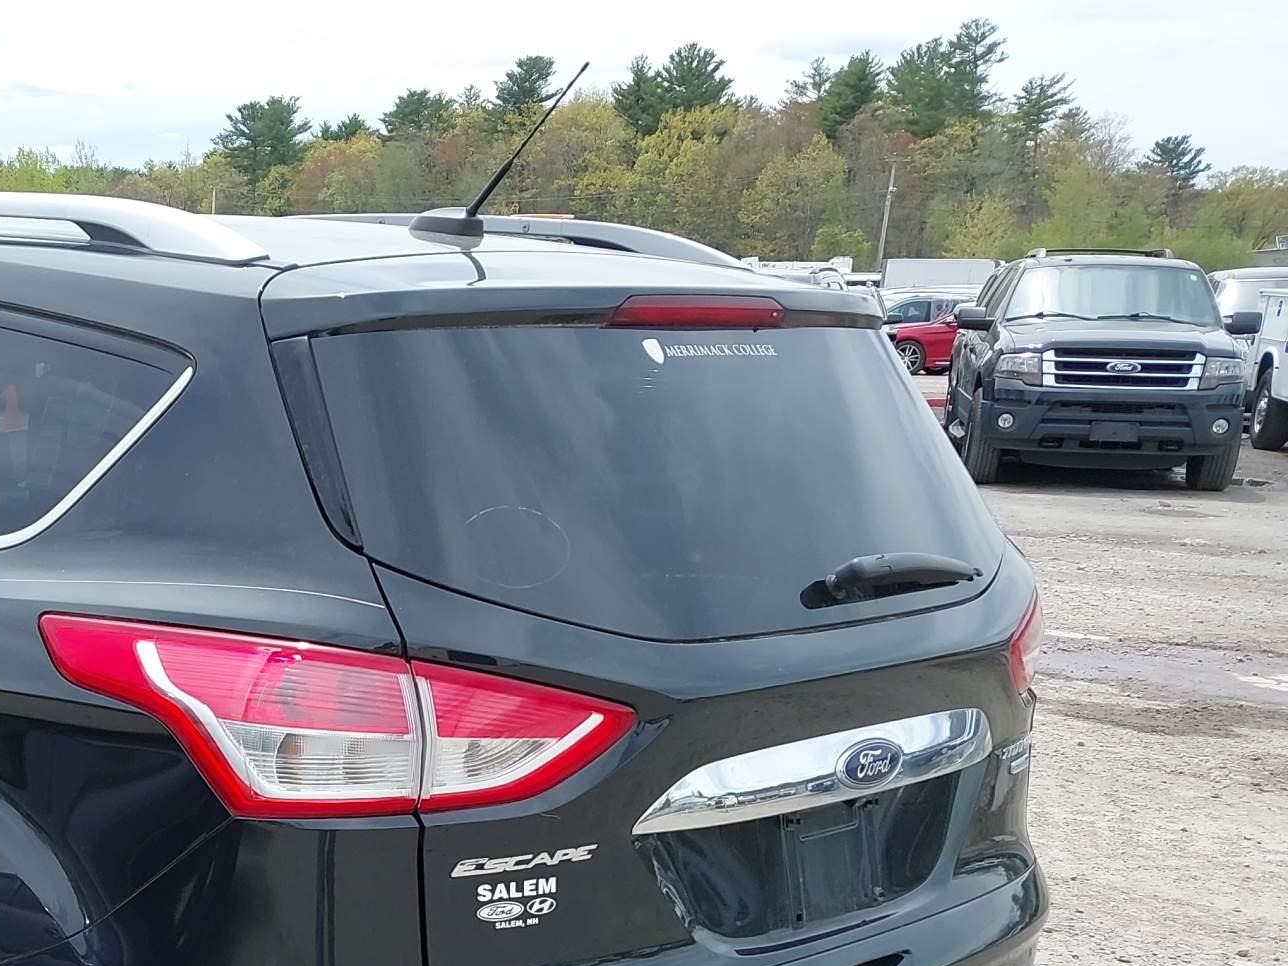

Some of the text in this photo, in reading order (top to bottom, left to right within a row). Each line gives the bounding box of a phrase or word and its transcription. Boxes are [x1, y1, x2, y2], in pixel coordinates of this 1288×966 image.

[665, 344, 778, 357] MERRIMACK COLLEGE
[857, 749, 891, 779] Ford
[451, 844, 598, 877] ESCAPE
[477, 877, 556, 901] SALEM
[486, 904, 514, 916] Ford
[495, 917, 539, 930] SALEM, NH
